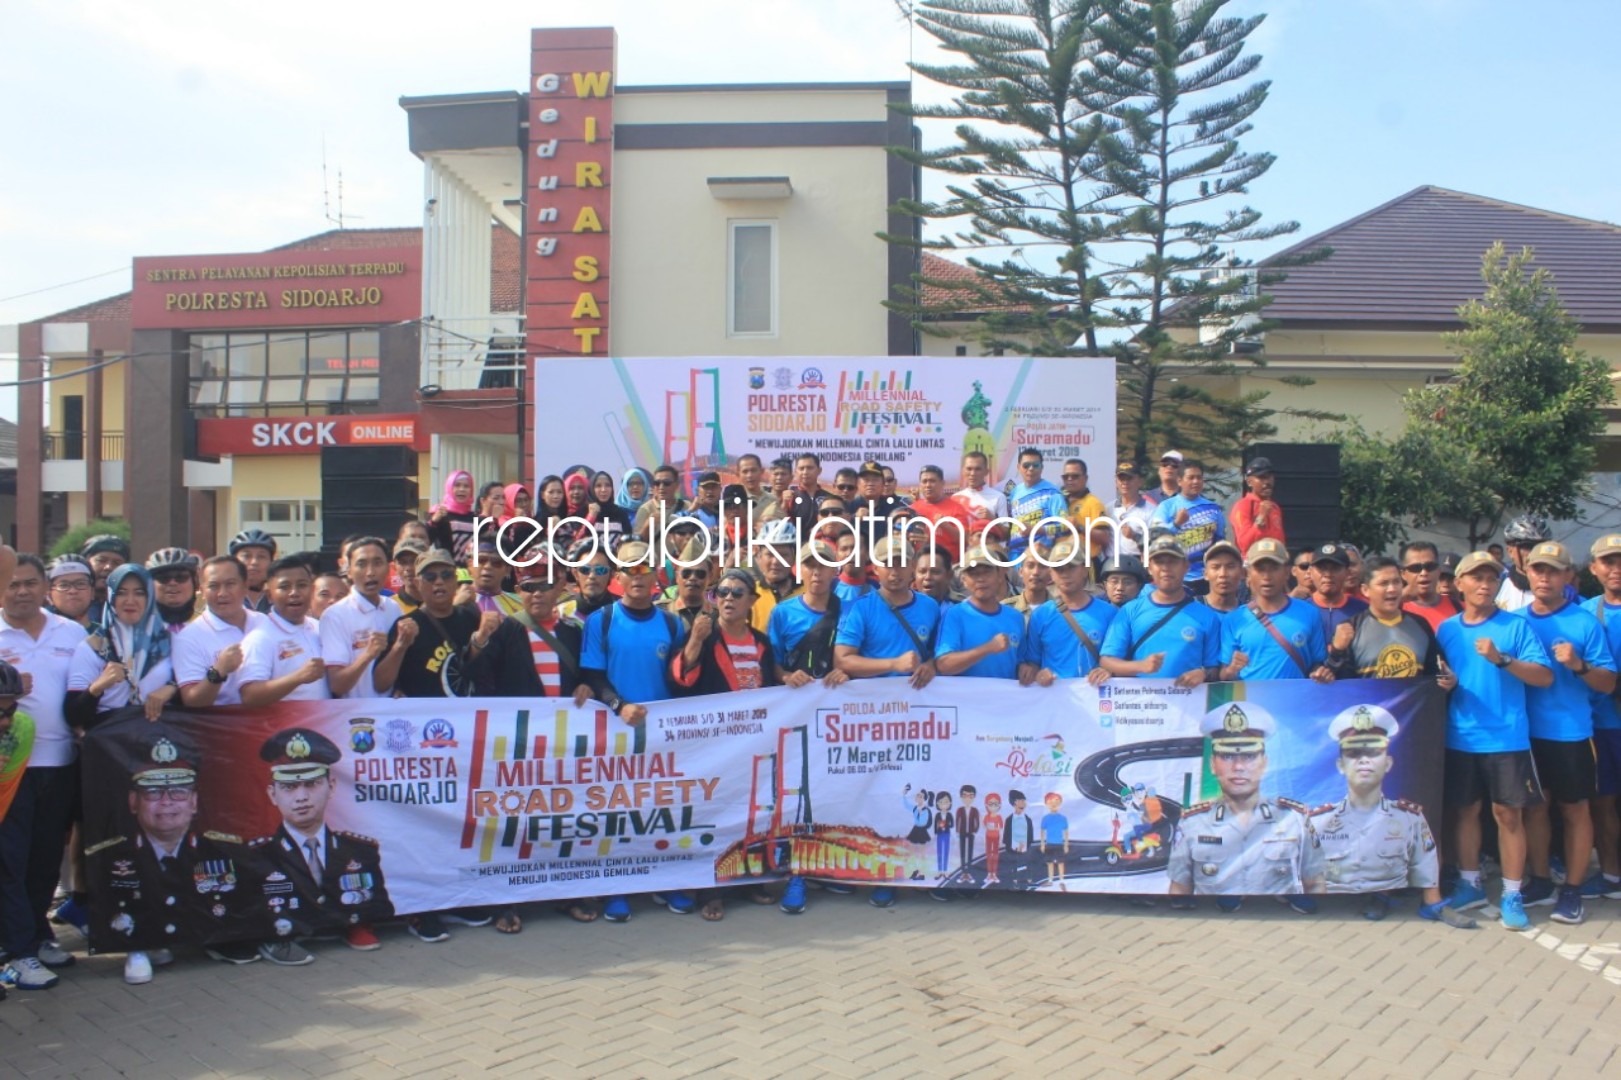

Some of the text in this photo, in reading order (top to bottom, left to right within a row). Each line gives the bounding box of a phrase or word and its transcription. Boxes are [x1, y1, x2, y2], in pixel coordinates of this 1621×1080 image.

[536, 73, 559, 256] Gedung
[146, 262, 405, 282] SENTRA PELAYANAN KEPOLISIAN TERPADU
[165, 287, 383, 310] POLRESTA SIDOARJO
[748, 394, 827, 412] POLRESTA
[850, 390, 927, 401] MILLENNIAL
[841, 402, 942, 412] ROAD SAFETY
[748, 414, 827, 432] SIDOARJO
[252, 421, 413, 448] SKCK ONLINE
[755, 438, 945, 449] MEWUJUDKAN MILLENNIAL CINTA LALU LINTAS
[1017, 428, 1090, 445] Suramadu
[864, 452, 905, 462] GEMILANG
[1059, 447, 1079, 457] 2019
[701, 713, 715, 724] S/D
[727, 709, 750, 722] MARET
[843, 701, 909, 715] POLDA JATIM
[677, 727, 710, 741] PROVINSI
[825, 711, 951, 743] Suramadu
[827, 743, 932, 765] 17 Maret 2019
[354, 756, 458, 782] POLRESTA
[495, 751, 685, 787] MILLENNIAL
[354, 780, 458, 805] SIDOARJO
[473, 777, 721, 818] ROAD SAFETY
[479, 853, 694, 876] MEWUJUDKAN MILLENNIAL CINTA LALU LINTAS
[508, 866, 650, 886] MENUJU INDONESIA GEMILANG
